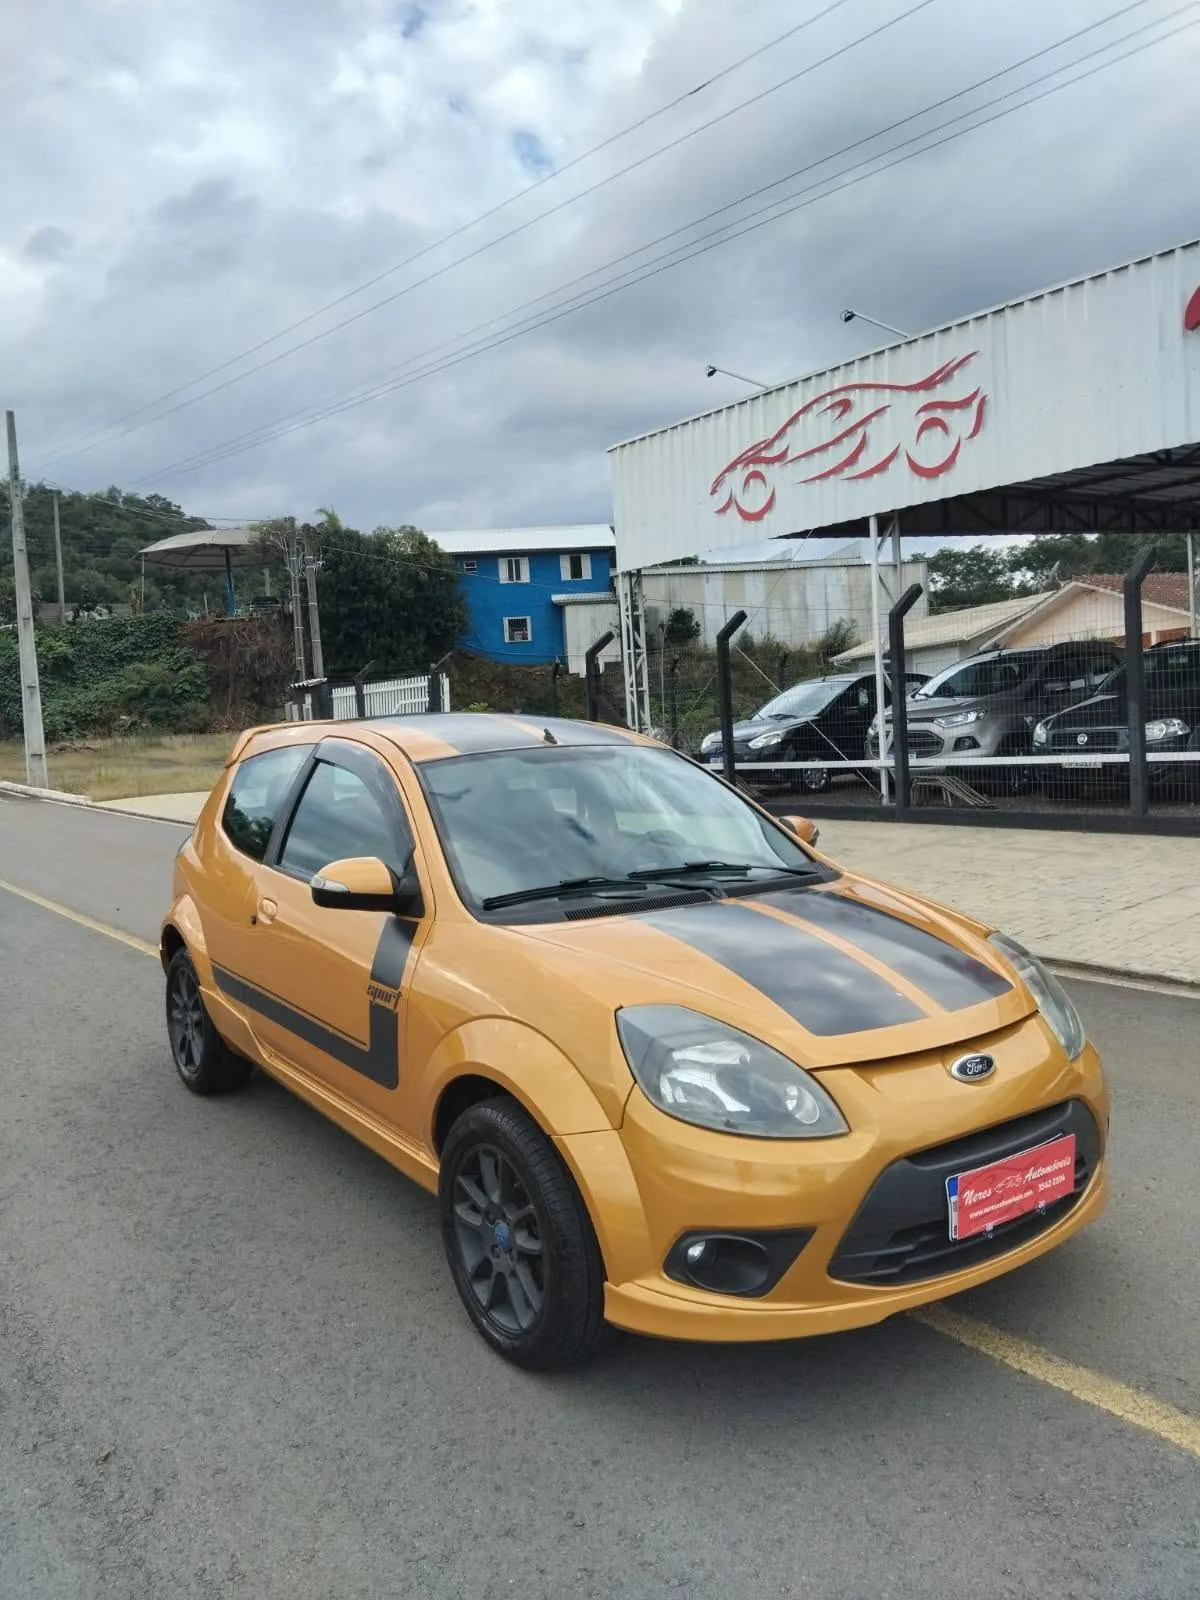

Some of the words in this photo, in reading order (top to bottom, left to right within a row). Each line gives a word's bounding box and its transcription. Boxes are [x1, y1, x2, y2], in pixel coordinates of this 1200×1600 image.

[367, 985, 402, 1010] sport
[967, 1058, 987, 1075] Ford
[963, 1187, 992, 1206] Neres
